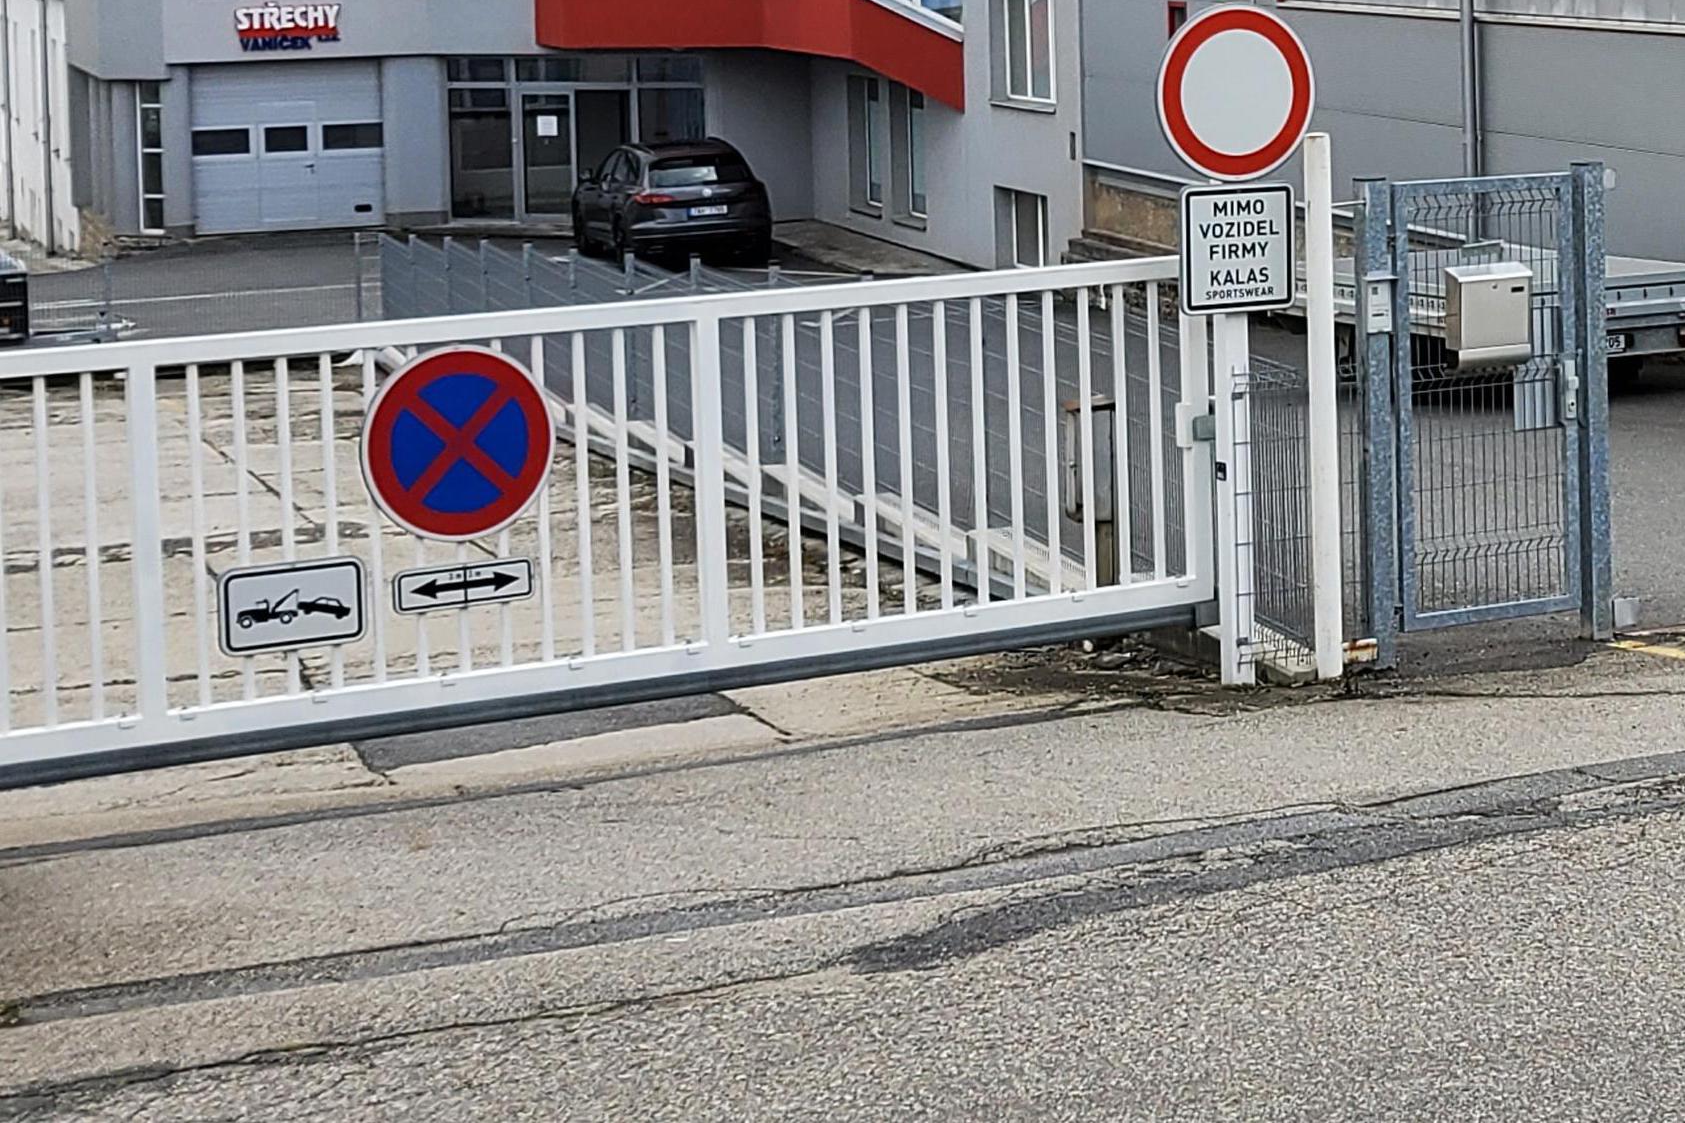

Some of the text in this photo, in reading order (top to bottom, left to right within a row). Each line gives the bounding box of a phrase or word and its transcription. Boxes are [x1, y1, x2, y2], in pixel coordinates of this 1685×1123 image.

[235, 2, 340, 31] STŘECHY
[1212, 199, 1265, 217] MIMO
[1198, 219, 1280, 239] VOZIDEL
[1209, 241, 1269, 261] FIRMY
[1210, 267, 1270, 287] KALAS
[1205, 286, 1275, 301] SPORTSWEAR
